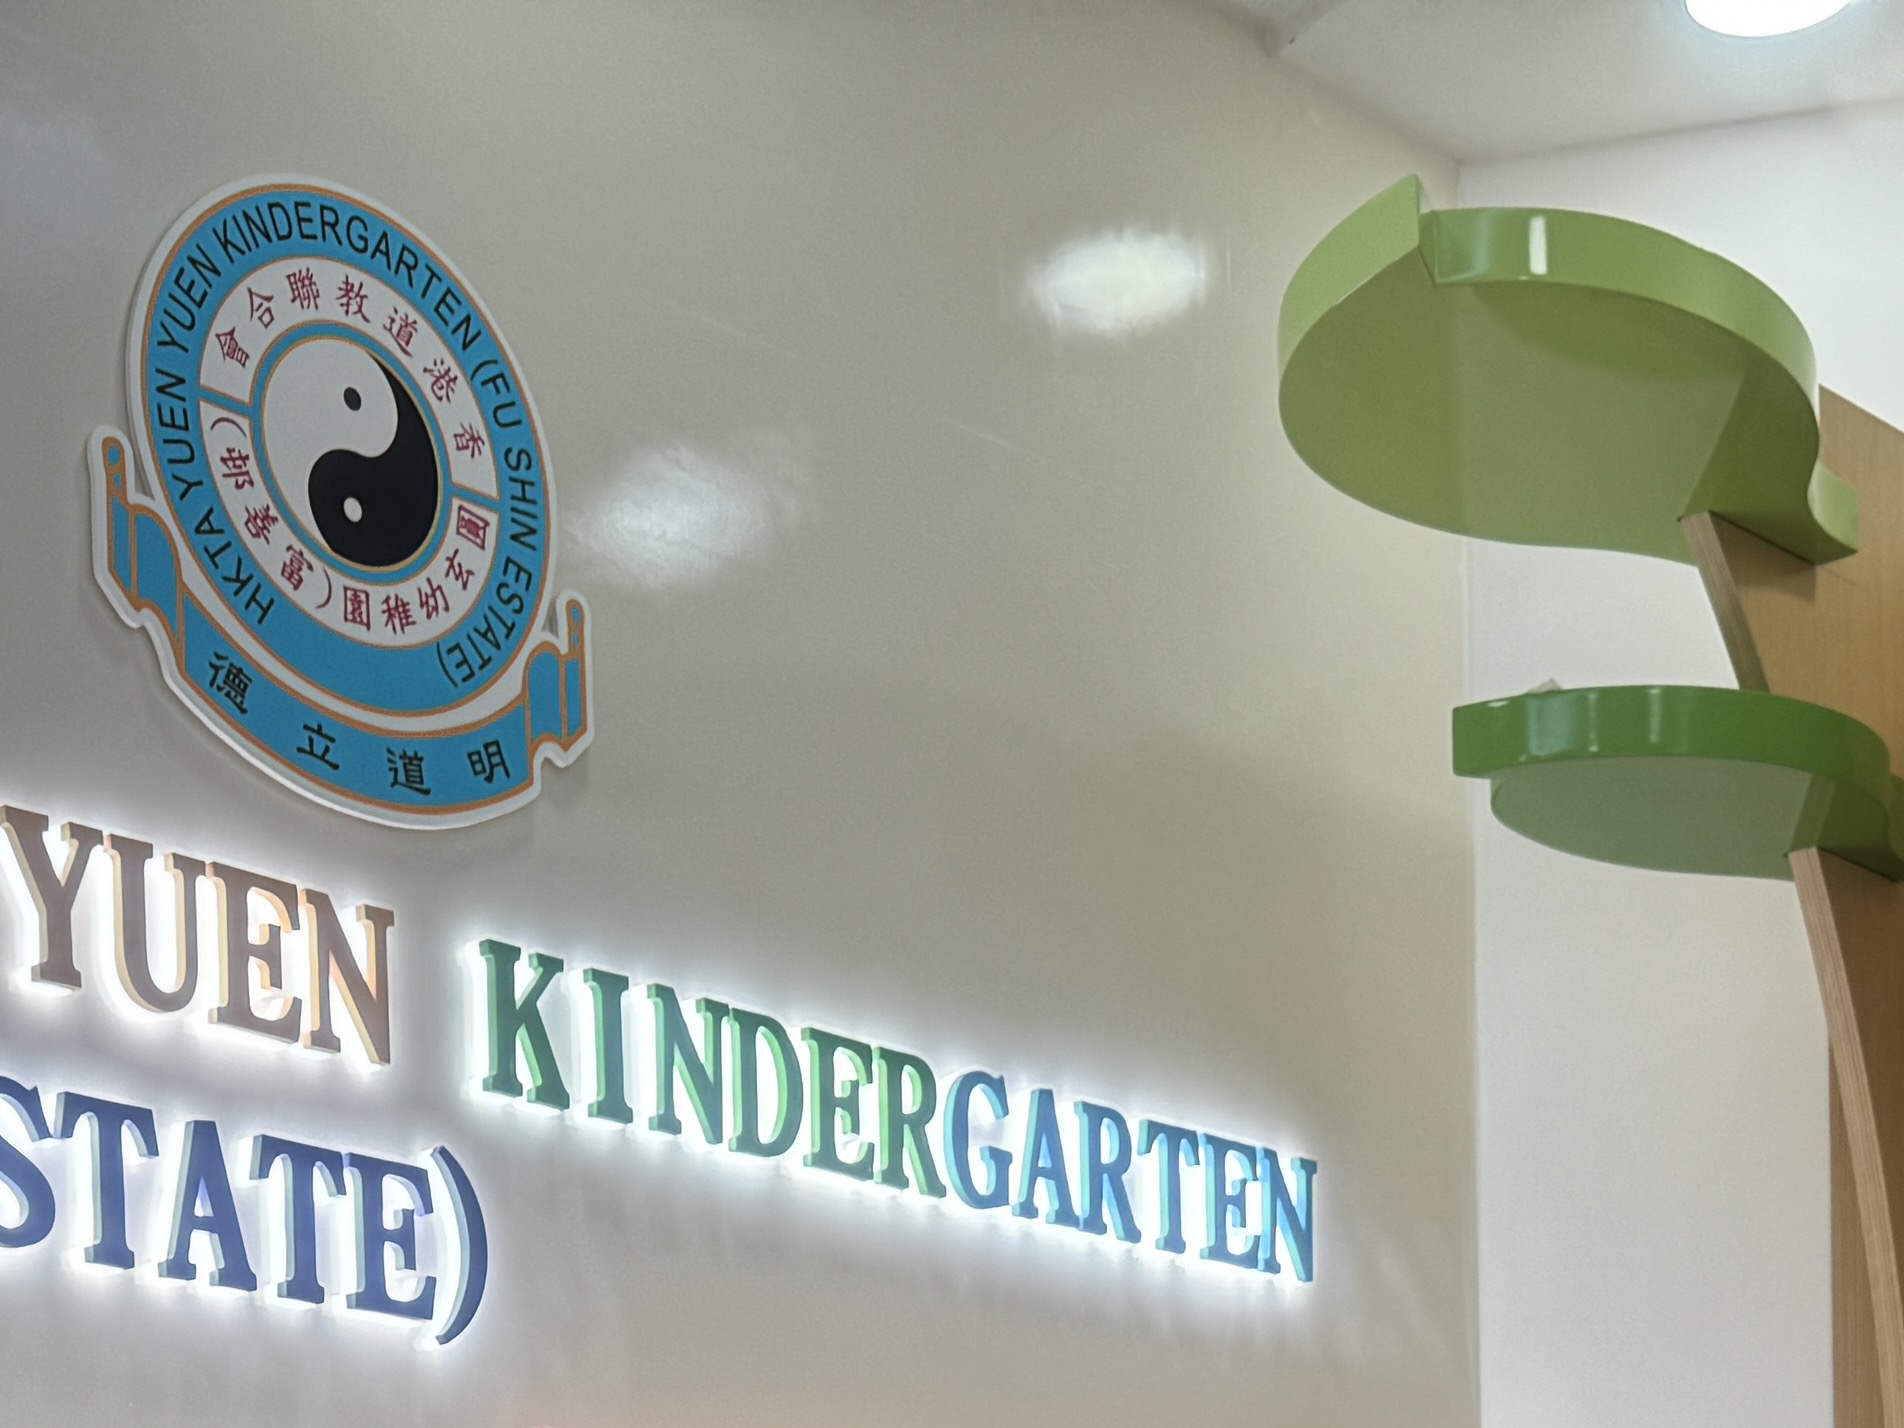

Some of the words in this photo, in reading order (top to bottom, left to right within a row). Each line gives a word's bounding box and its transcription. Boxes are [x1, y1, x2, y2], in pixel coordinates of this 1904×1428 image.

[156, 238, 224, 357] YUEN
[213, 200, 483, 354] KINDERGARTEN
[152, 367, 205, 503] YUEN
[469, 357, 525, 431] (FU
[503, 447, 539, 551] SHIN
[193, 504, 276, 627] HKTA
[435, 561, 534, 690] ESTATE)
[477, 937, 1318, 1283] KINDERGARTEN
